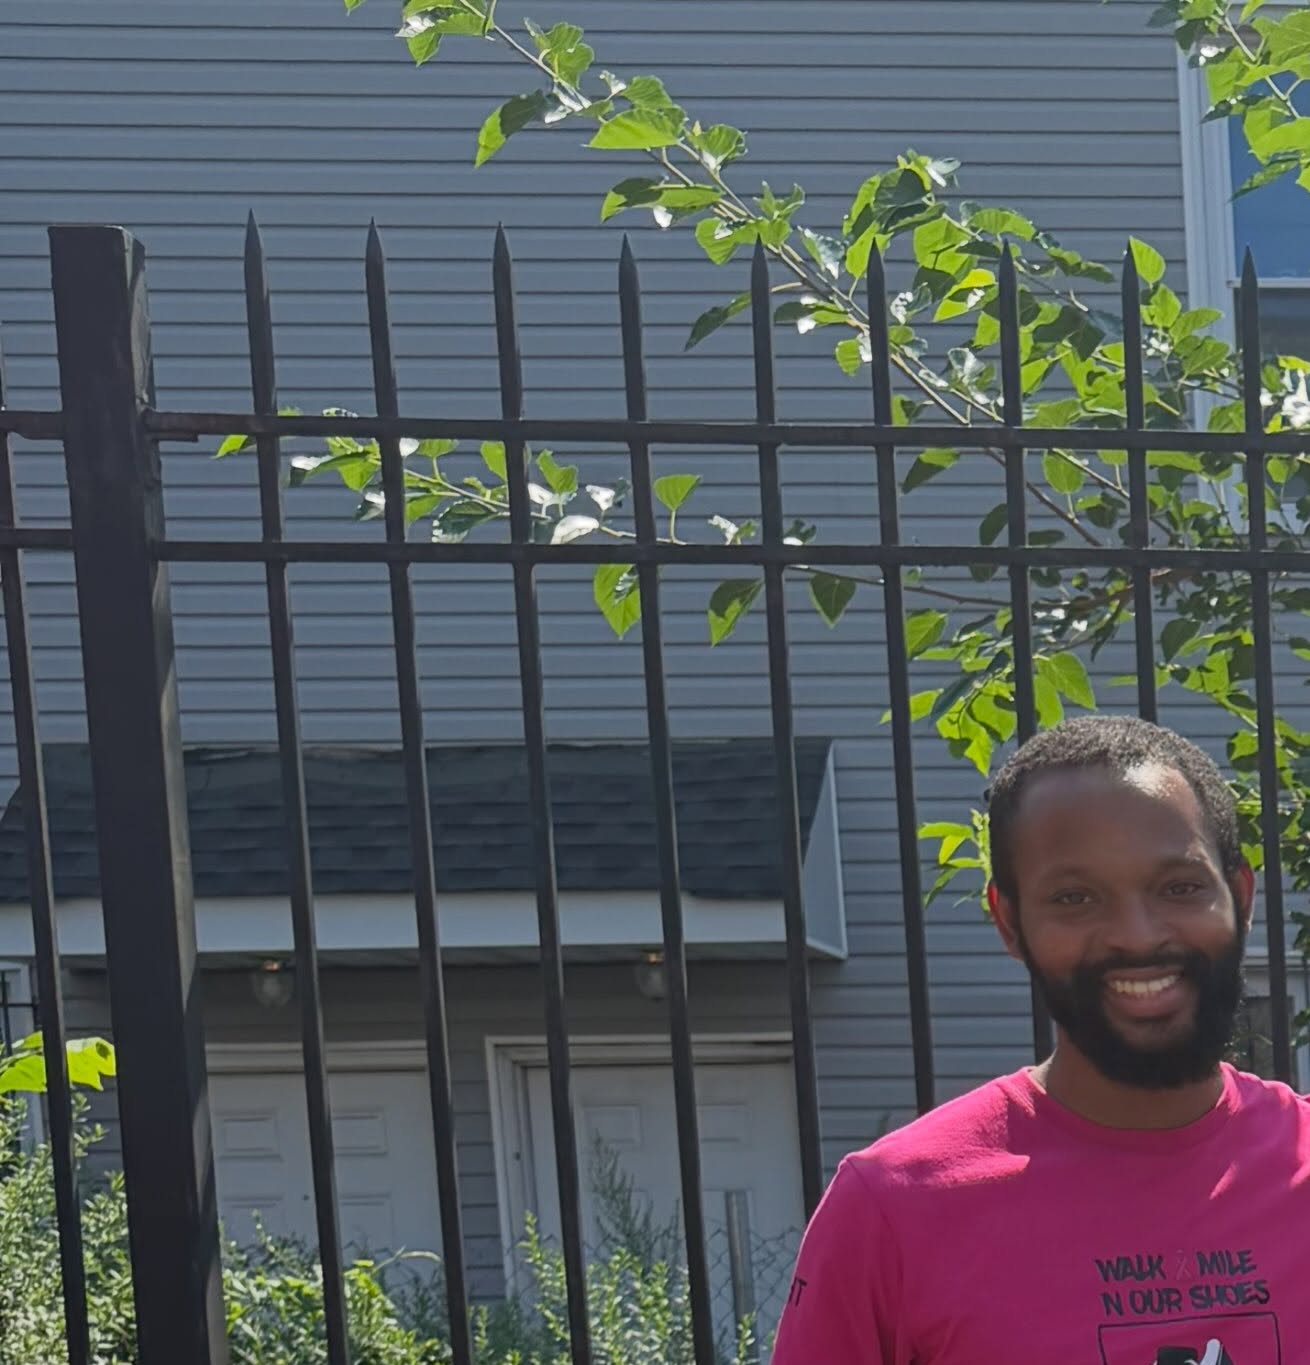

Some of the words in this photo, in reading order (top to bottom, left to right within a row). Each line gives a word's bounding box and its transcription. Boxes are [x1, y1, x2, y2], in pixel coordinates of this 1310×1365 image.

[1093, 1254, 1167, 1283] WALK
[1195, 1249, 1258, 1277] MILE
[1101, 1292, 1124, 1317] N
[1129, 1286, 1183, 1315] OUR
[1188, 1278, 1271, 1311] SHOES
